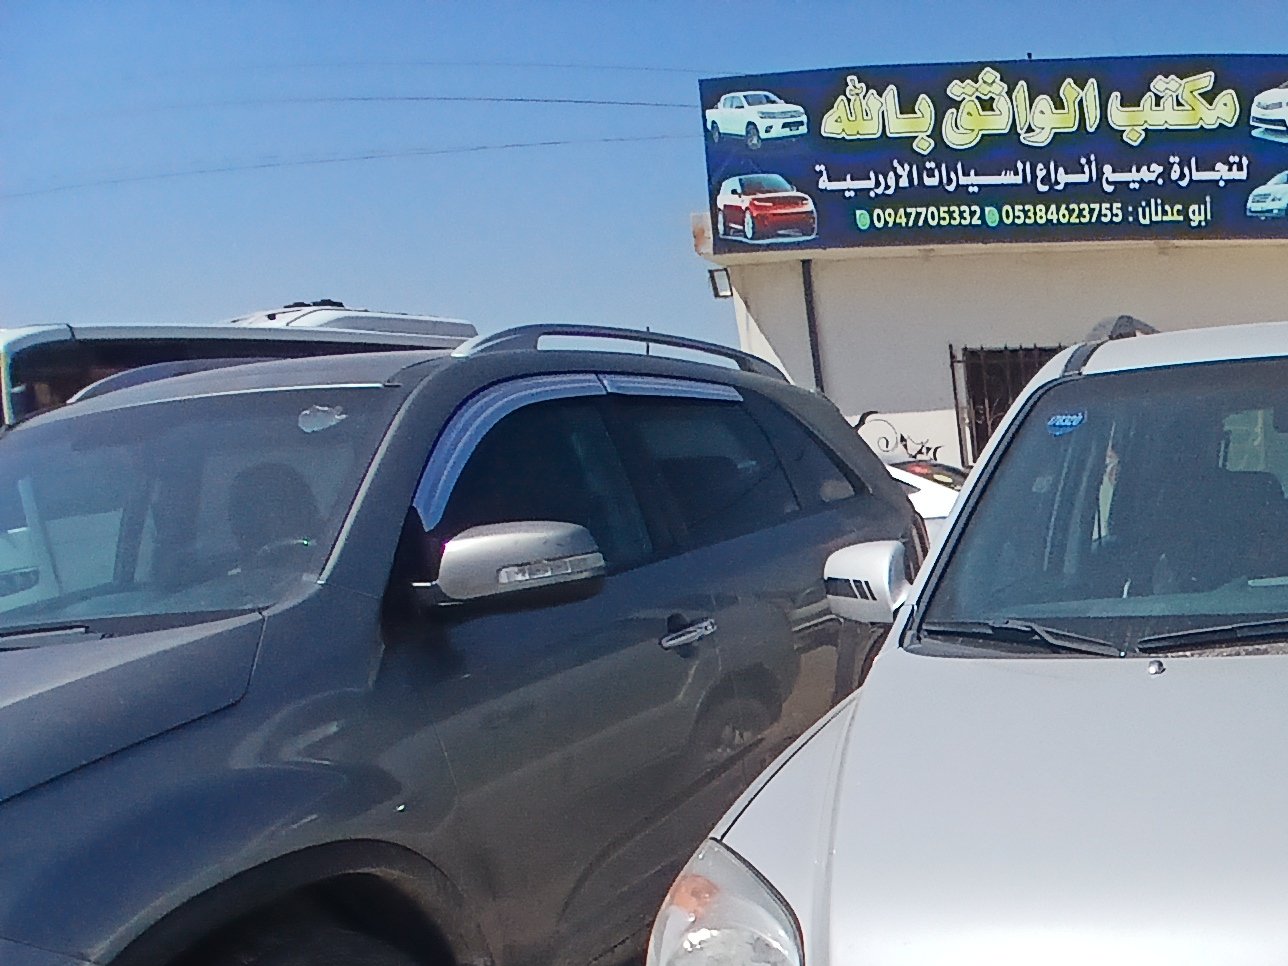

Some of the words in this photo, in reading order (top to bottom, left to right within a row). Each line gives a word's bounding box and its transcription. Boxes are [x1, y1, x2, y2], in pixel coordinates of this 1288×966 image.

[821, 75, 935, 155] بالله
[942, 67, 1100, 149] الواثق
[1107, 70, 1240, 146] مكتب
[815, 159, 918, 197] الأوربية
[923, 160, 1031, 193] السيارات
[1036, 153, 1097, 192] أنواع
[1102, 163, 1164, 192] جميع
[1169, 155, 1249, 187] لتجارة
[873, 206, 982, 228] 0947705332
[1002, 203, 1123, 225] 05384623755
[1138, 198, 1184, 225] عدنان
[1188, 195, 1212, 227] أبو
